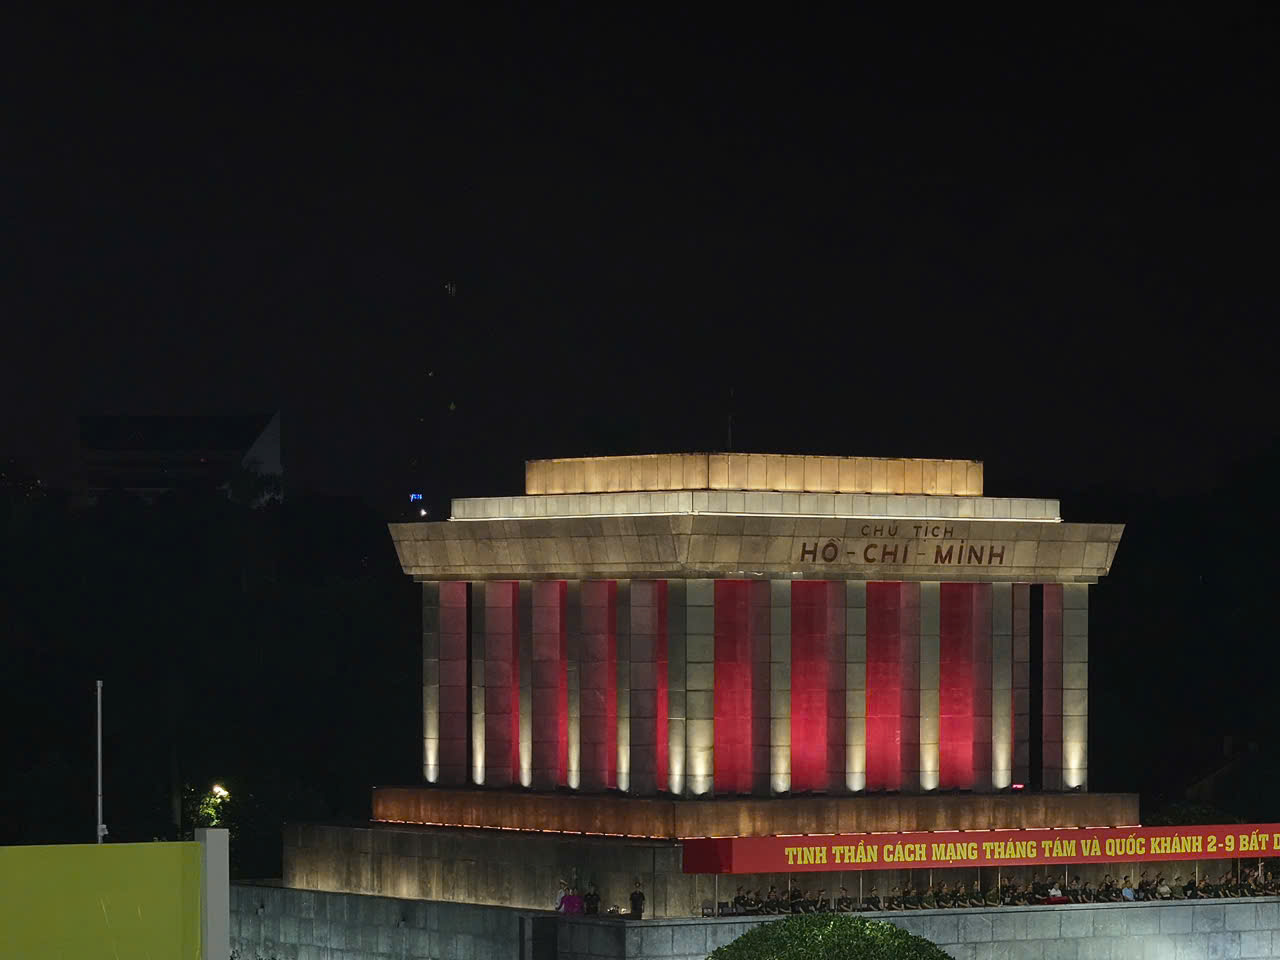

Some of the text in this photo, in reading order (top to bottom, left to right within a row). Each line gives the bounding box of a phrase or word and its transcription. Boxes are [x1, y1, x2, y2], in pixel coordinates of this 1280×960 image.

[934, 539, 1006, 565] MINH
[784, 846, 828, 865] TINH
[831, 839, 879, 863] THẦN
[883, 840, 927, 863] CÁCH
[931, 842, 978, 864] MẠNG
[982, 837, 1037, 860] THÁNG
[1041, 835, 1076, 858] TÁM
[1080, 835, 1102, 857] VÀ
[1105, 832, 1146, 857] QUỐC
[1150, 832, 1203, 855] KHÁNH
[1239, 829, 1269, 852] BẤT
